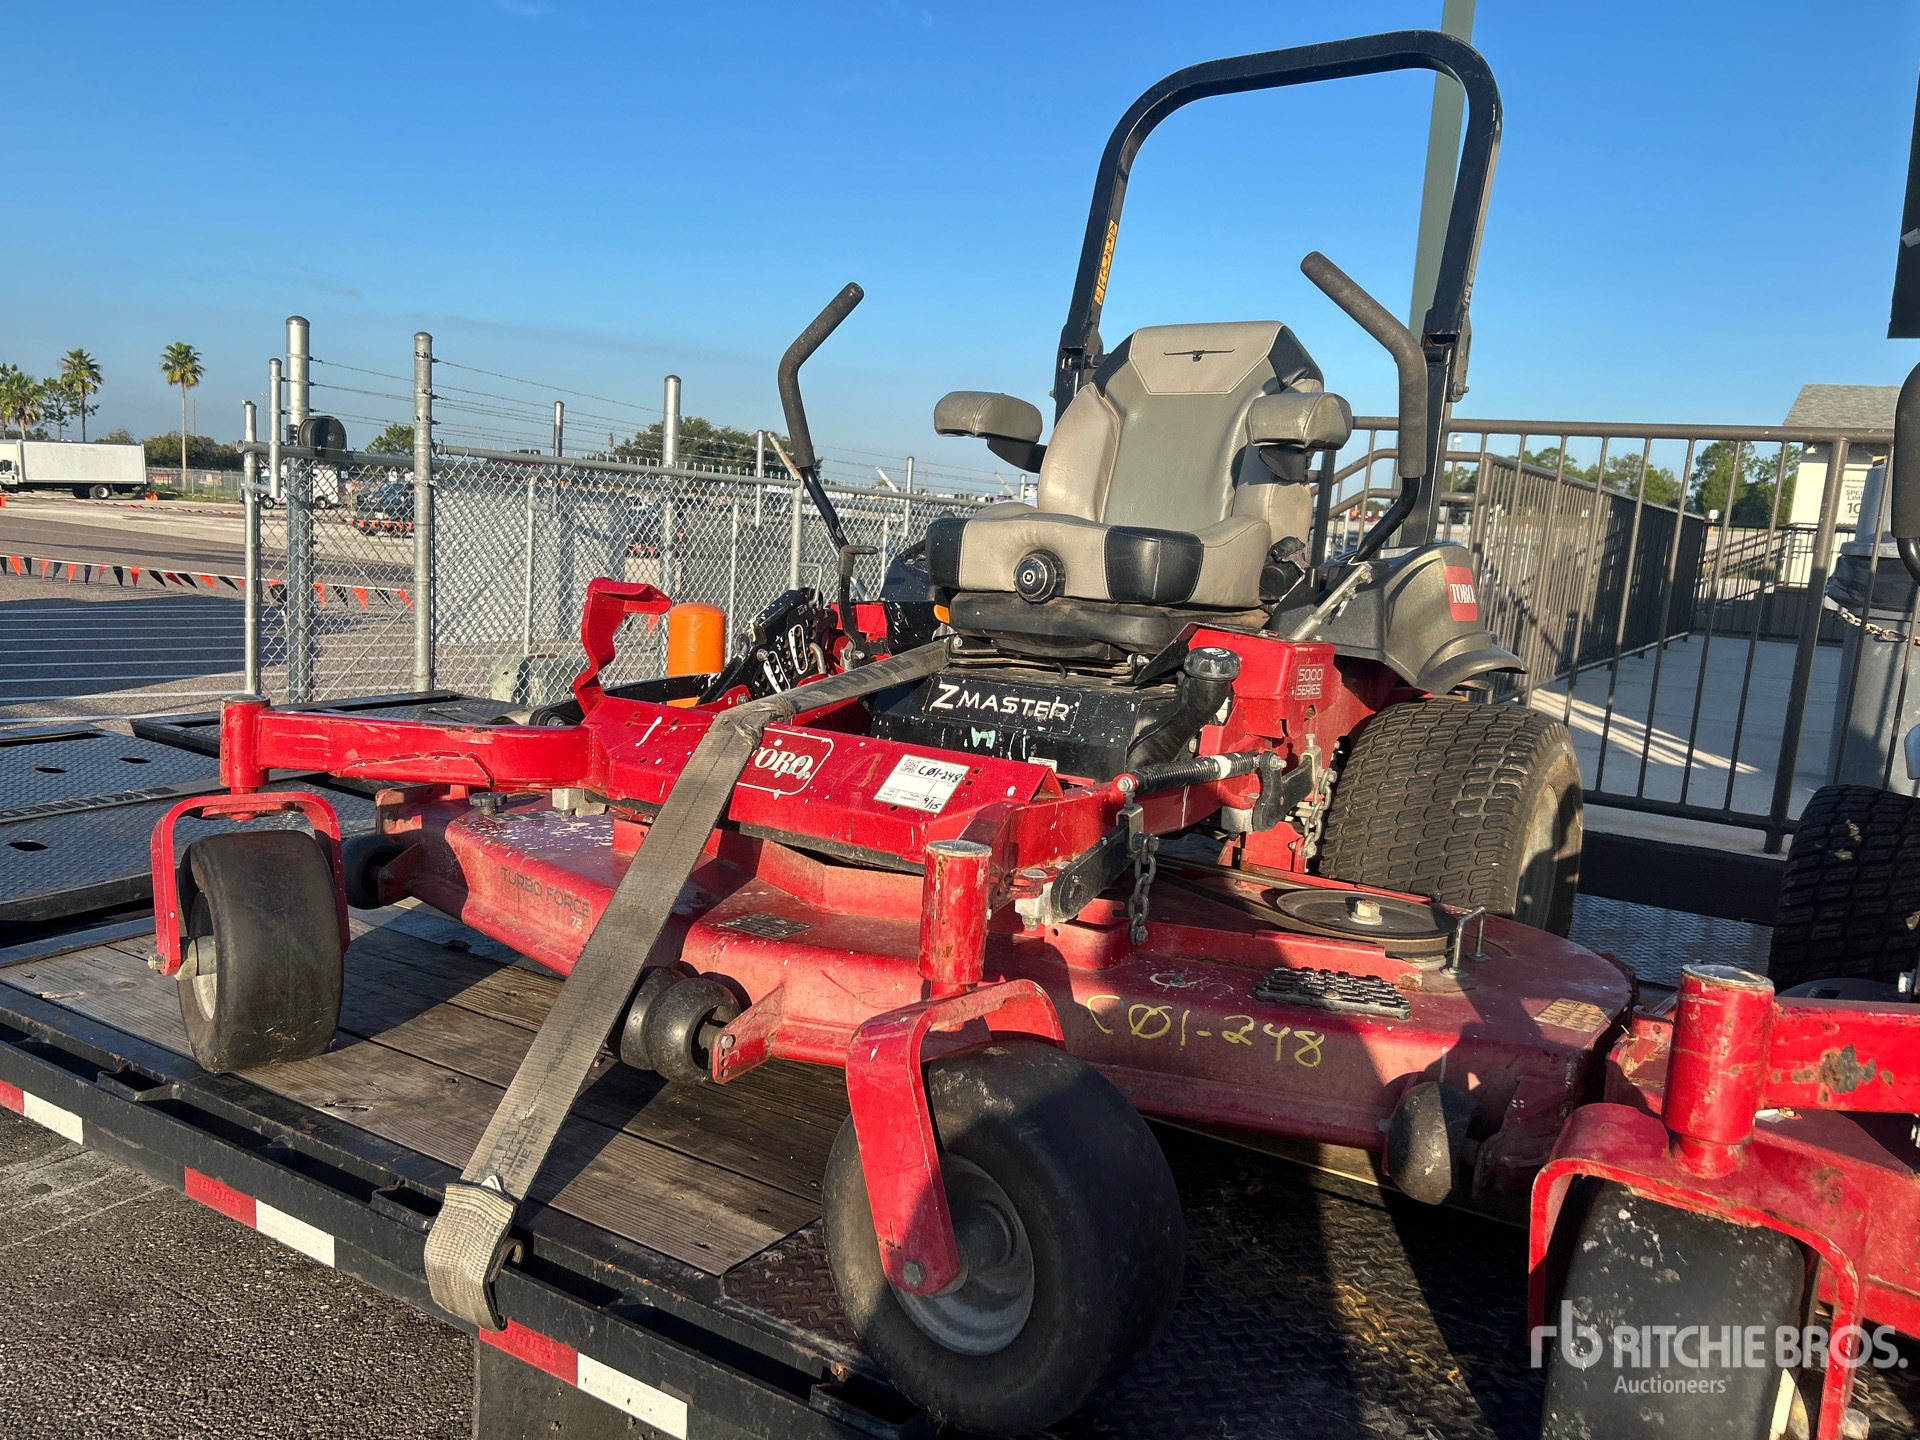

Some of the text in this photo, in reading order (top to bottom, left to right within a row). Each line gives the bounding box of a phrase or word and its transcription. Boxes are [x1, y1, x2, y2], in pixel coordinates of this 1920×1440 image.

[1450, 583, 1476, 604] TORO
[1298, 668, 1322, 682] 5000
[1296, 684, 1321, 696] SERIES
[930, 683, 1070, 721] Z MASTER
[501, 866, 590, 918] TURBO FORCE
[571, 915, 584, 930] 72
[200, 1179, 241, 1208] BigTex
